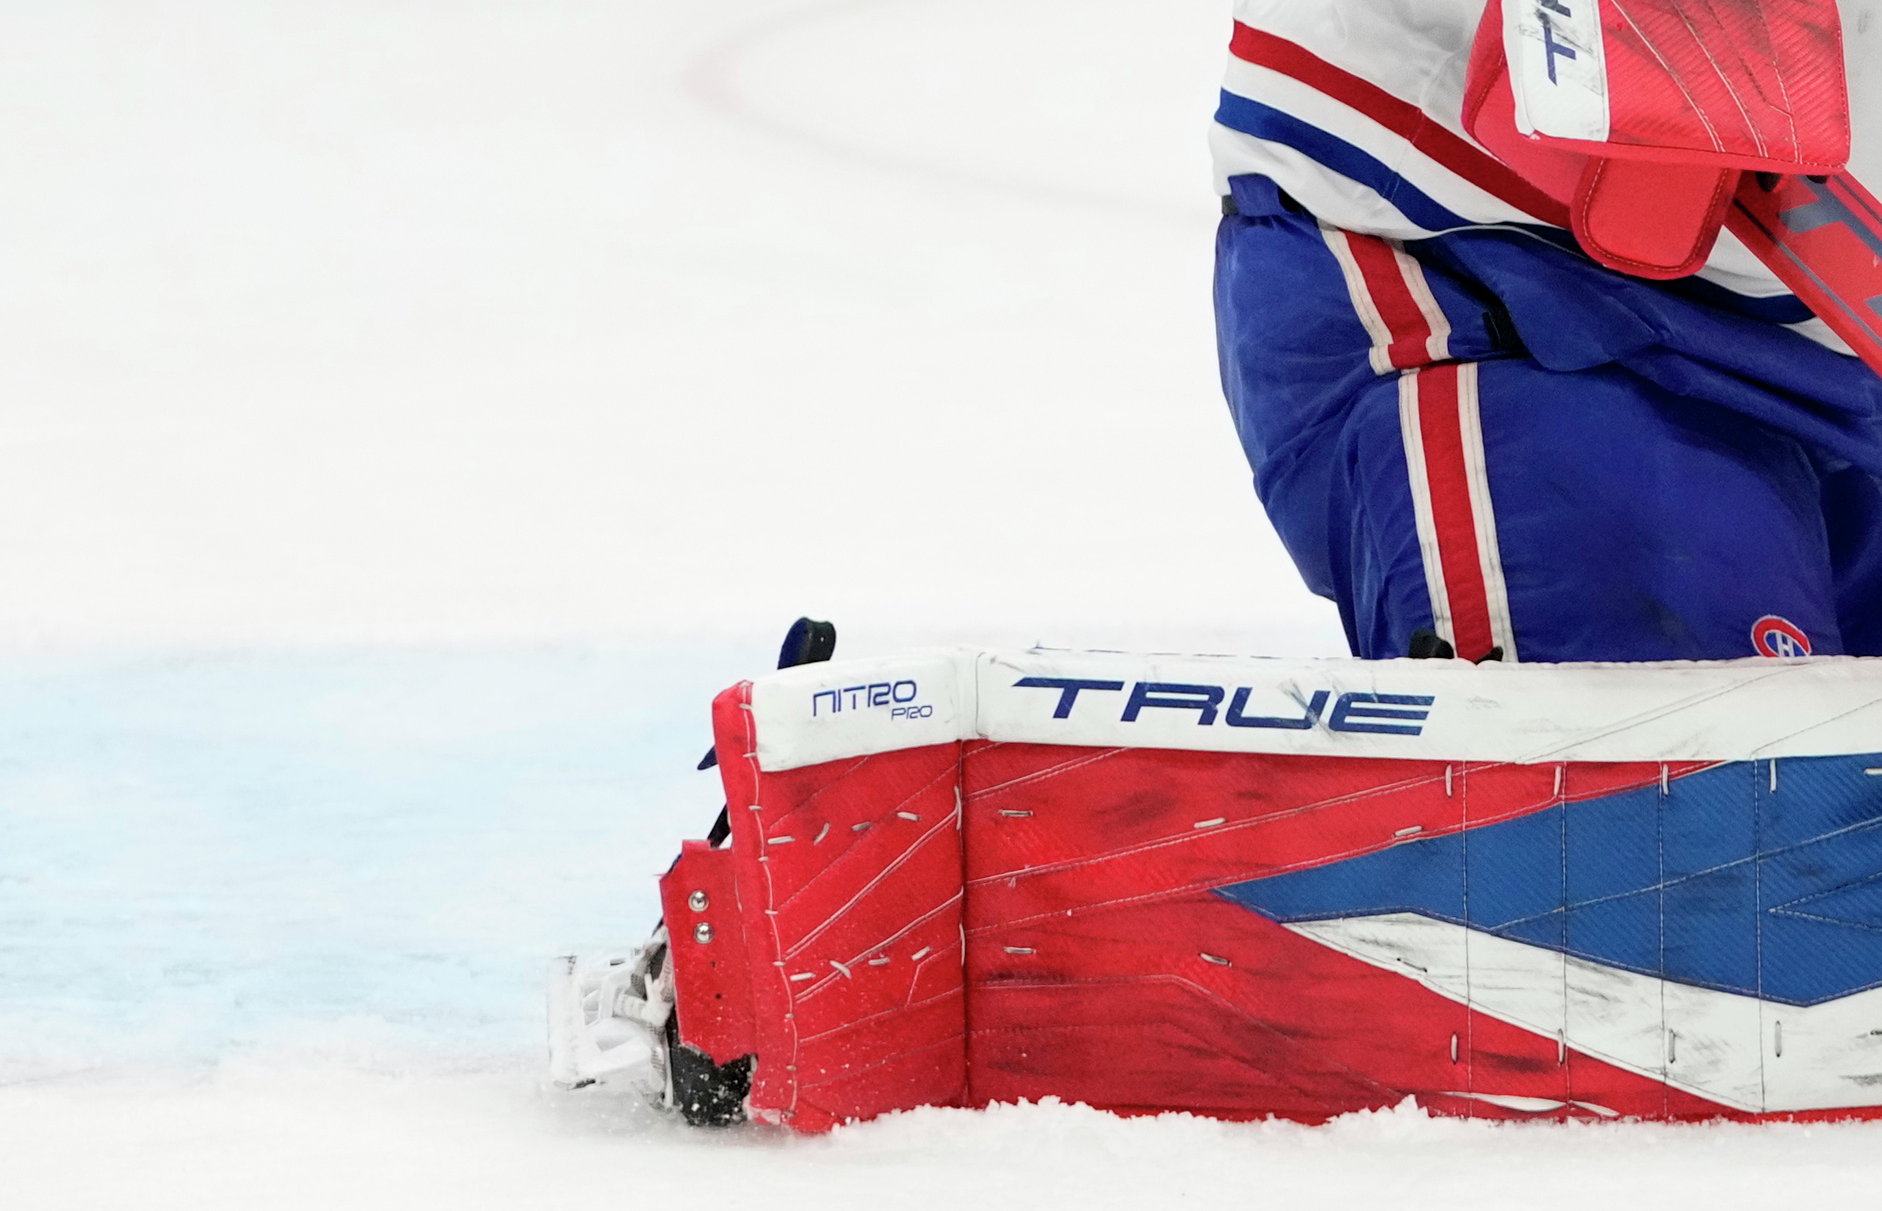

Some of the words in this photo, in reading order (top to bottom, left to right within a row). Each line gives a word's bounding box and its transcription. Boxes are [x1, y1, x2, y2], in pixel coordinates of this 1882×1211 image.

[813, 679, 917, 717] NITRO
[891, 705, 933, 721] PRO
[1011, 676, 1436, 737] TRUE
